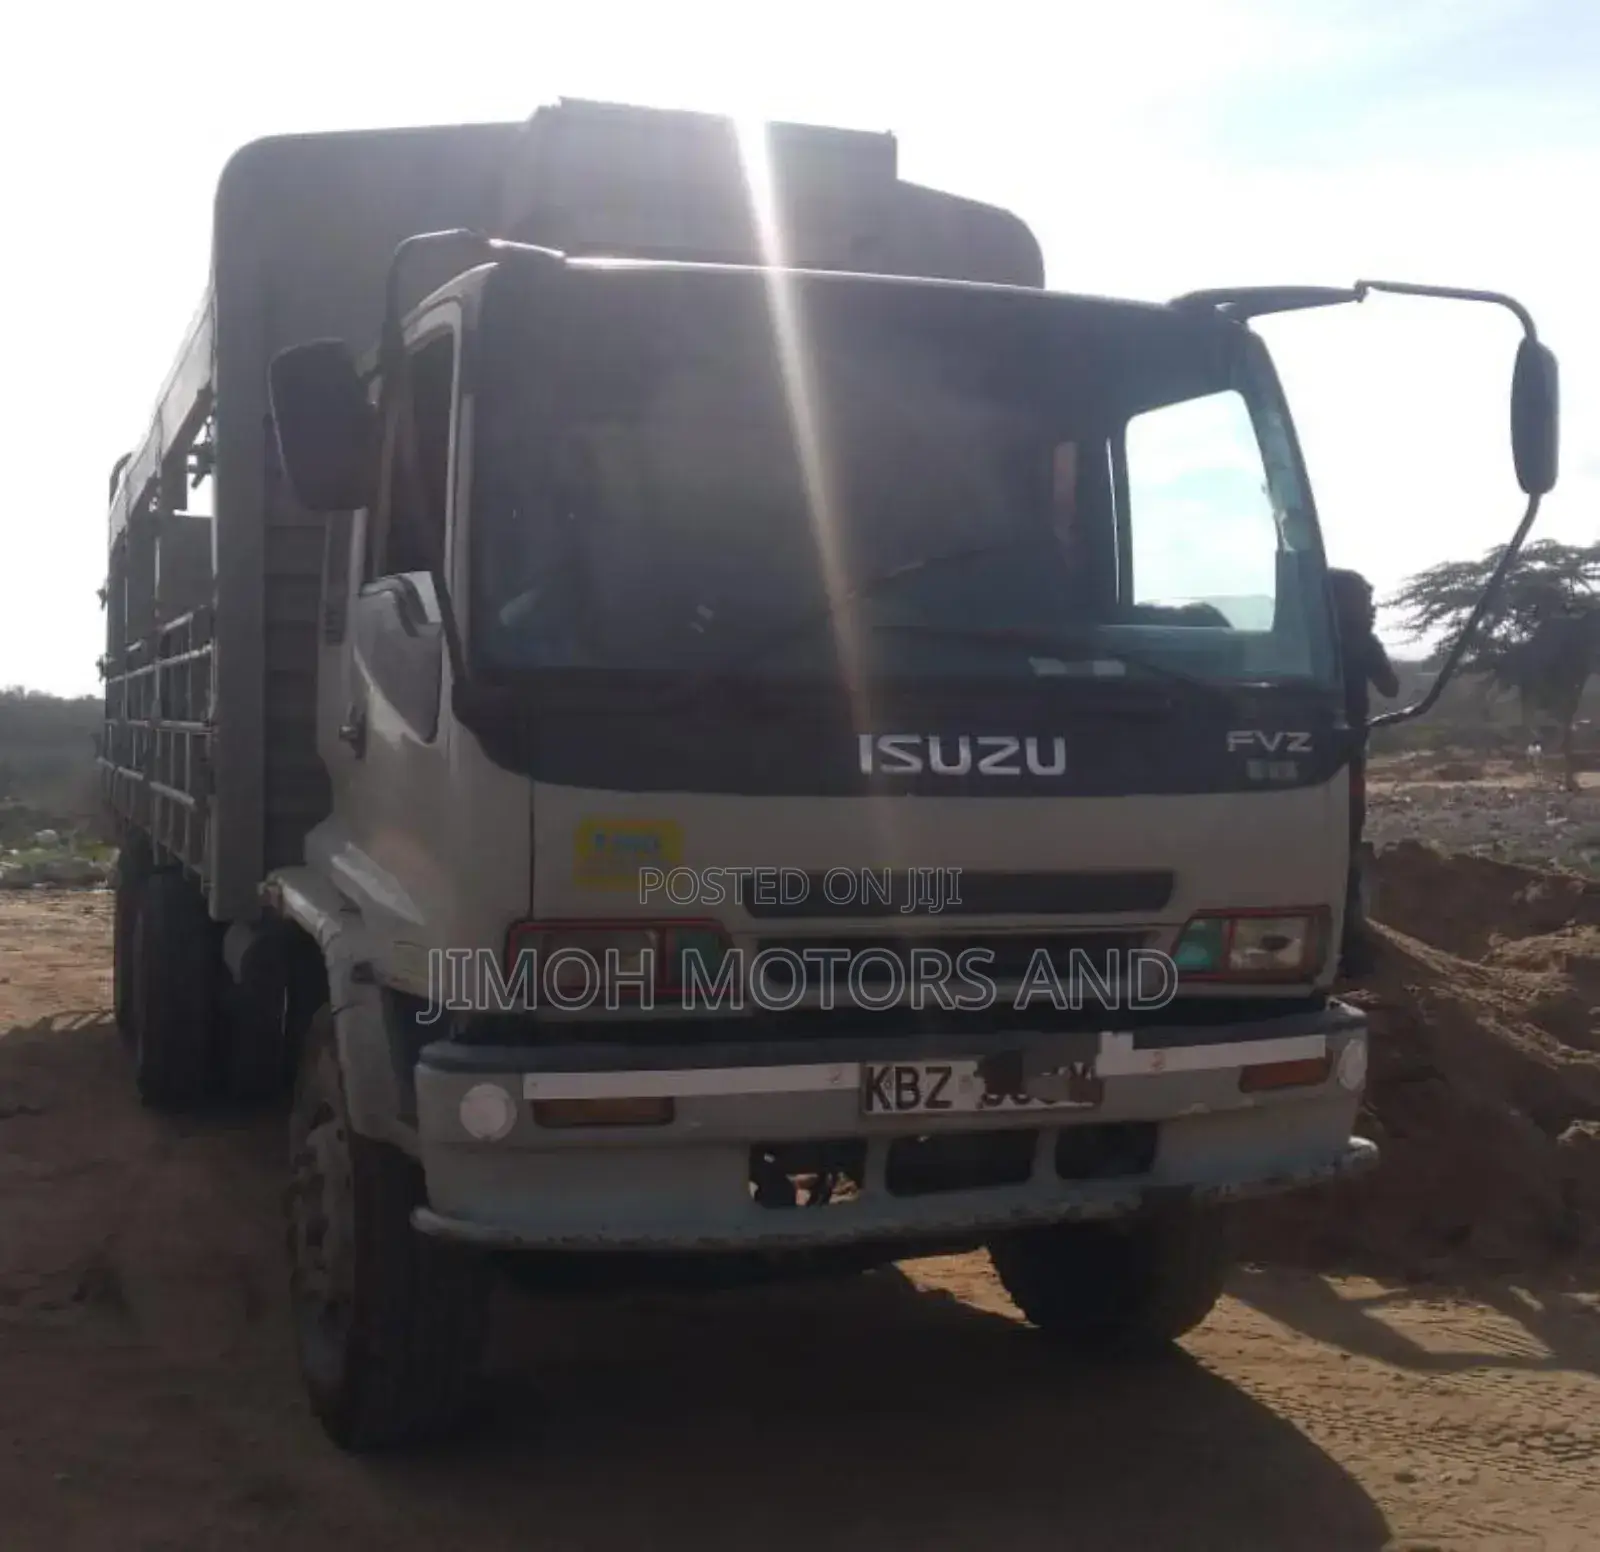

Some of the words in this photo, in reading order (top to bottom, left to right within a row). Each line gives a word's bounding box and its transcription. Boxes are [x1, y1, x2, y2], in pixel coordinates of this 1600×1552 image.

[860, 733, 1067, 776] ISUZU
[1226, 730, 1314, 752] FVZ
[865, 1066, 953, 1111] KBZ
